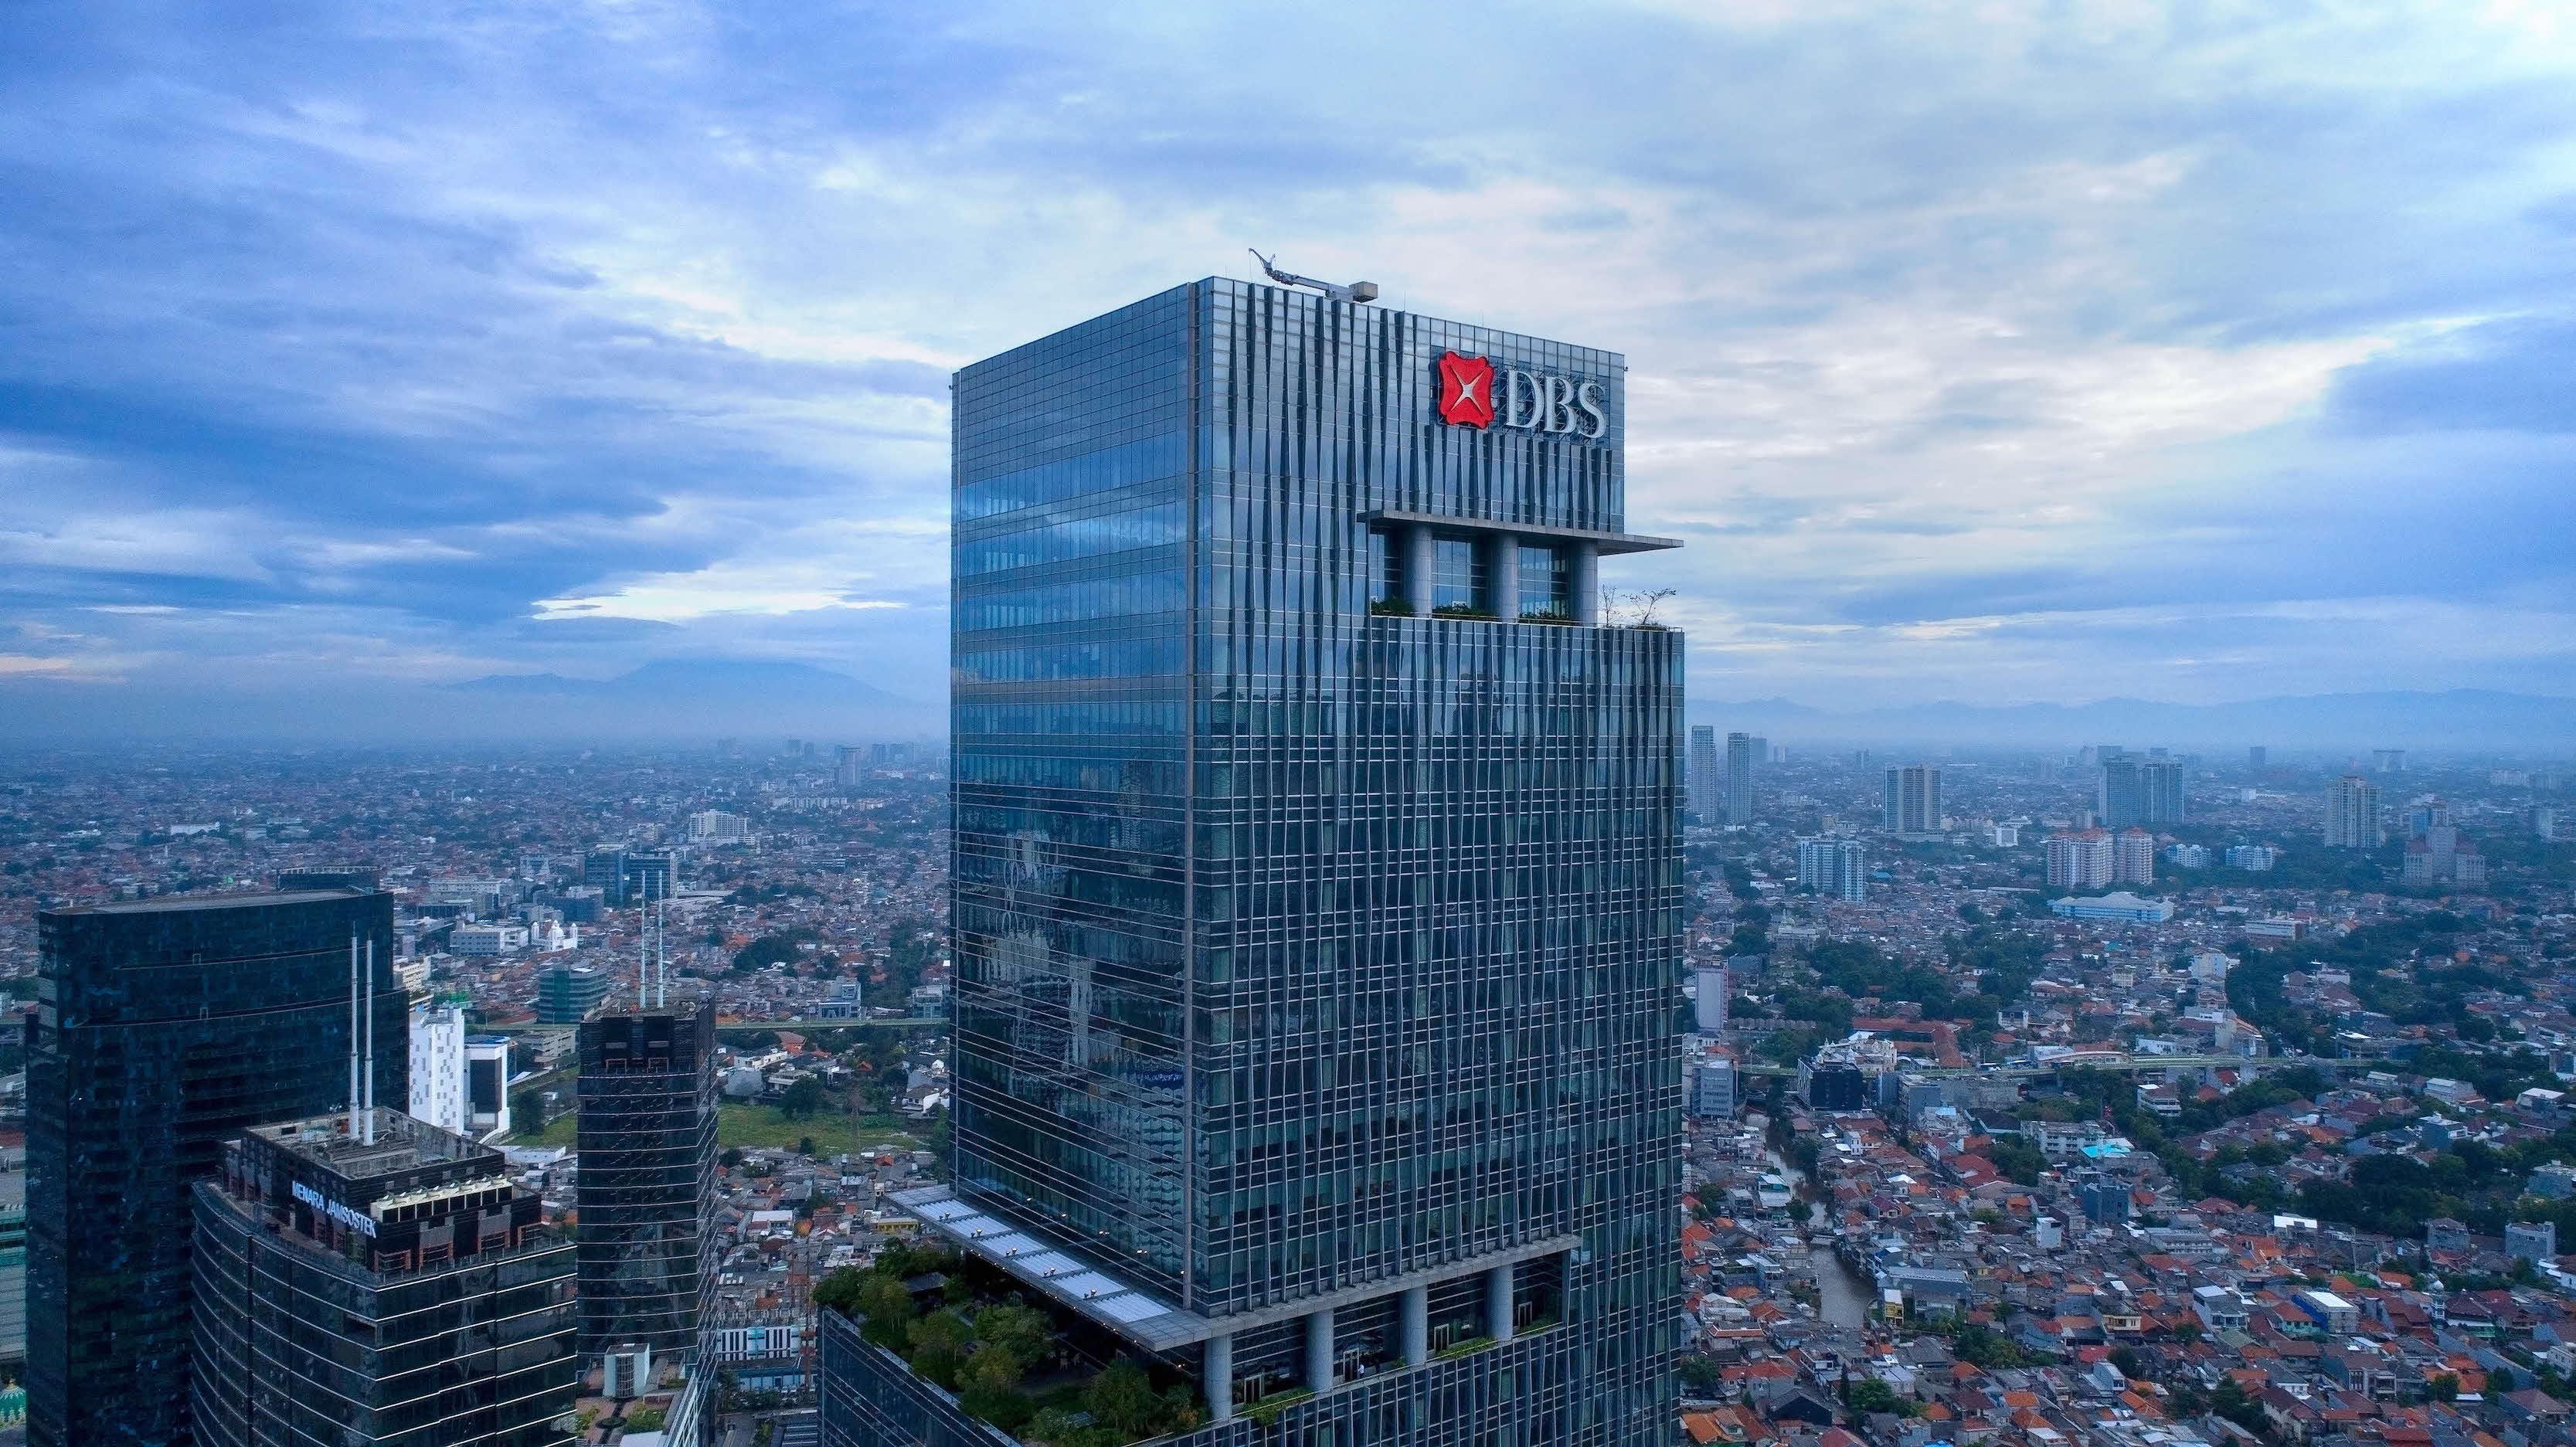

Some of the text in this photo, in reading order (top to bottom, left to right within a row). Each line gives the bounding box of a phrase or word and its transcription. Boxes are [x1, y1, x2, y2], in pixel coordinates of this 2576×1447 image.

[1504, 369, 1606, 438] DBS
[292, 1180, 376, 1238] MENARA JAMSOSTEK
